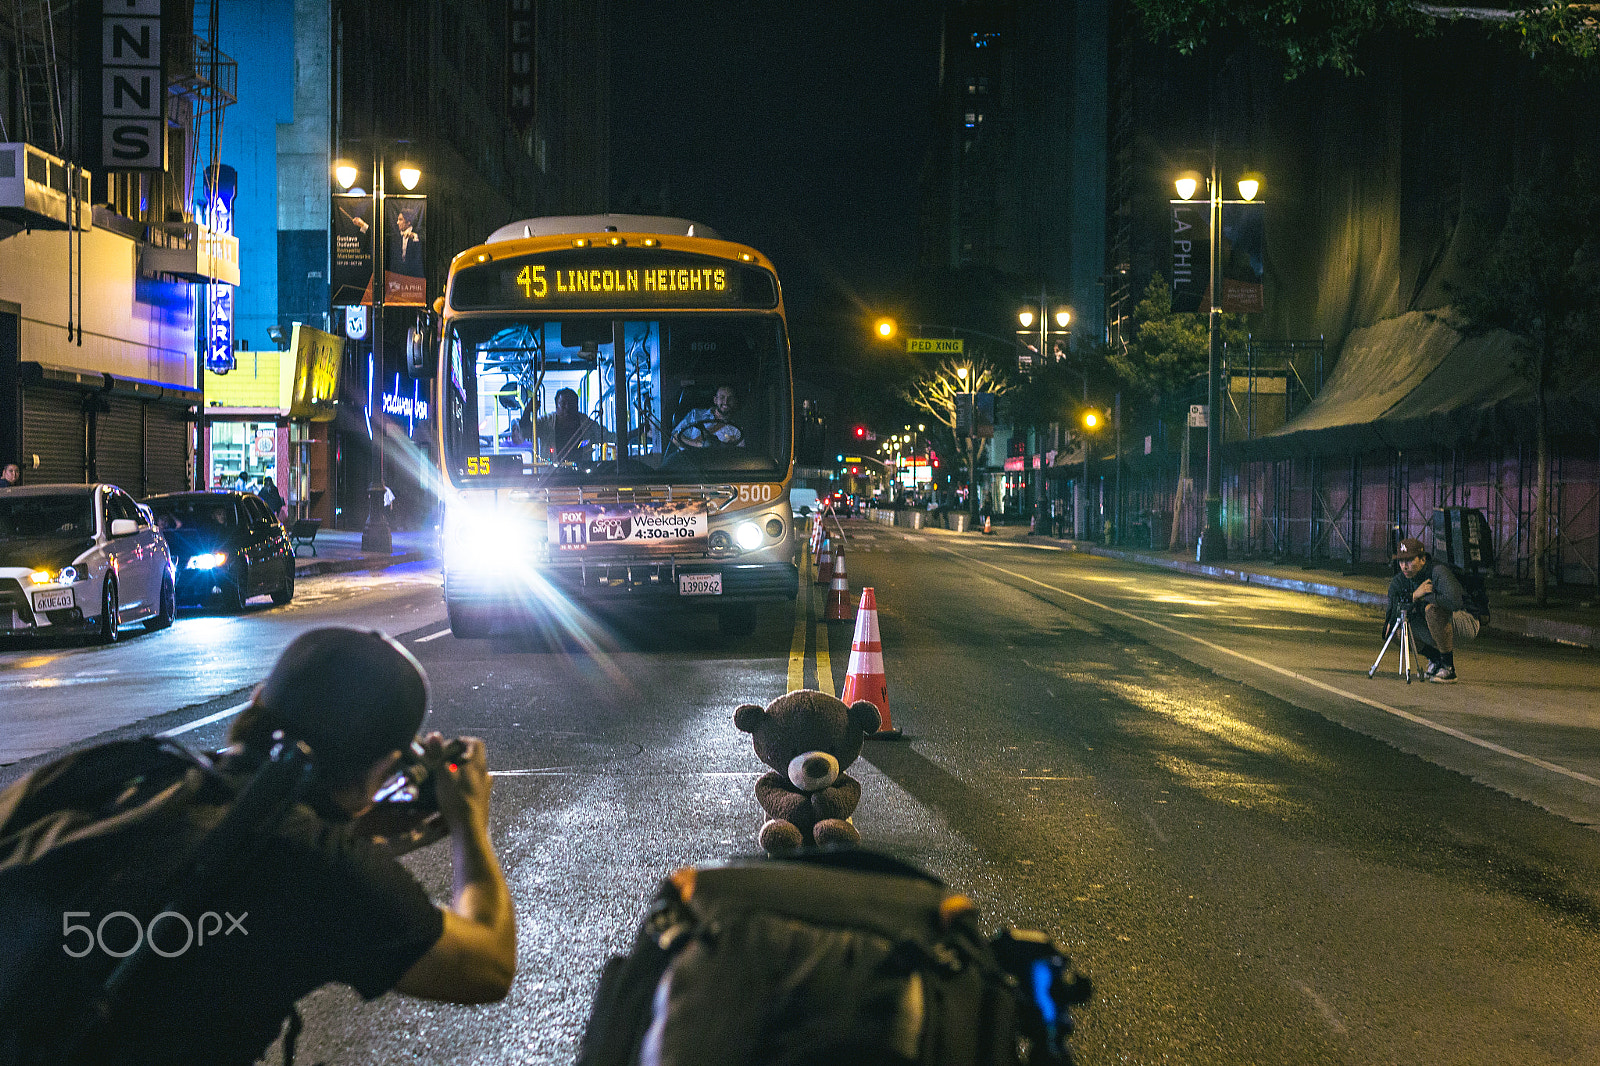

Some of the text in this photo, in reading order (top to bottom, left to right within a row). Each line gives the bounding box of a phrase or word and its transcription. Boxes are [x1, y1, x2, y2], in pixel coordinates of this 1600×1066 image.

[112, 0, 150, 161] NNS
[1174, 208, 1192, 289] LA PHIL
[516, 265, 726, 298] 45 LINCOLN HEIGHTS
[911, 341, 959, 351] PED XING
[467, 456, 491, 475] 55
[731, 484, 771, 502] 500
[562, 512, 583, 522] FOX
[633, 515, 697, 527] Weekdays
[563, 523, 582, 544] 11
[592, 526, 626, 540] DAY LA
[634, 527, 695, 539] 4:30a-10a
[682, 581, 720, 593] 1390962
